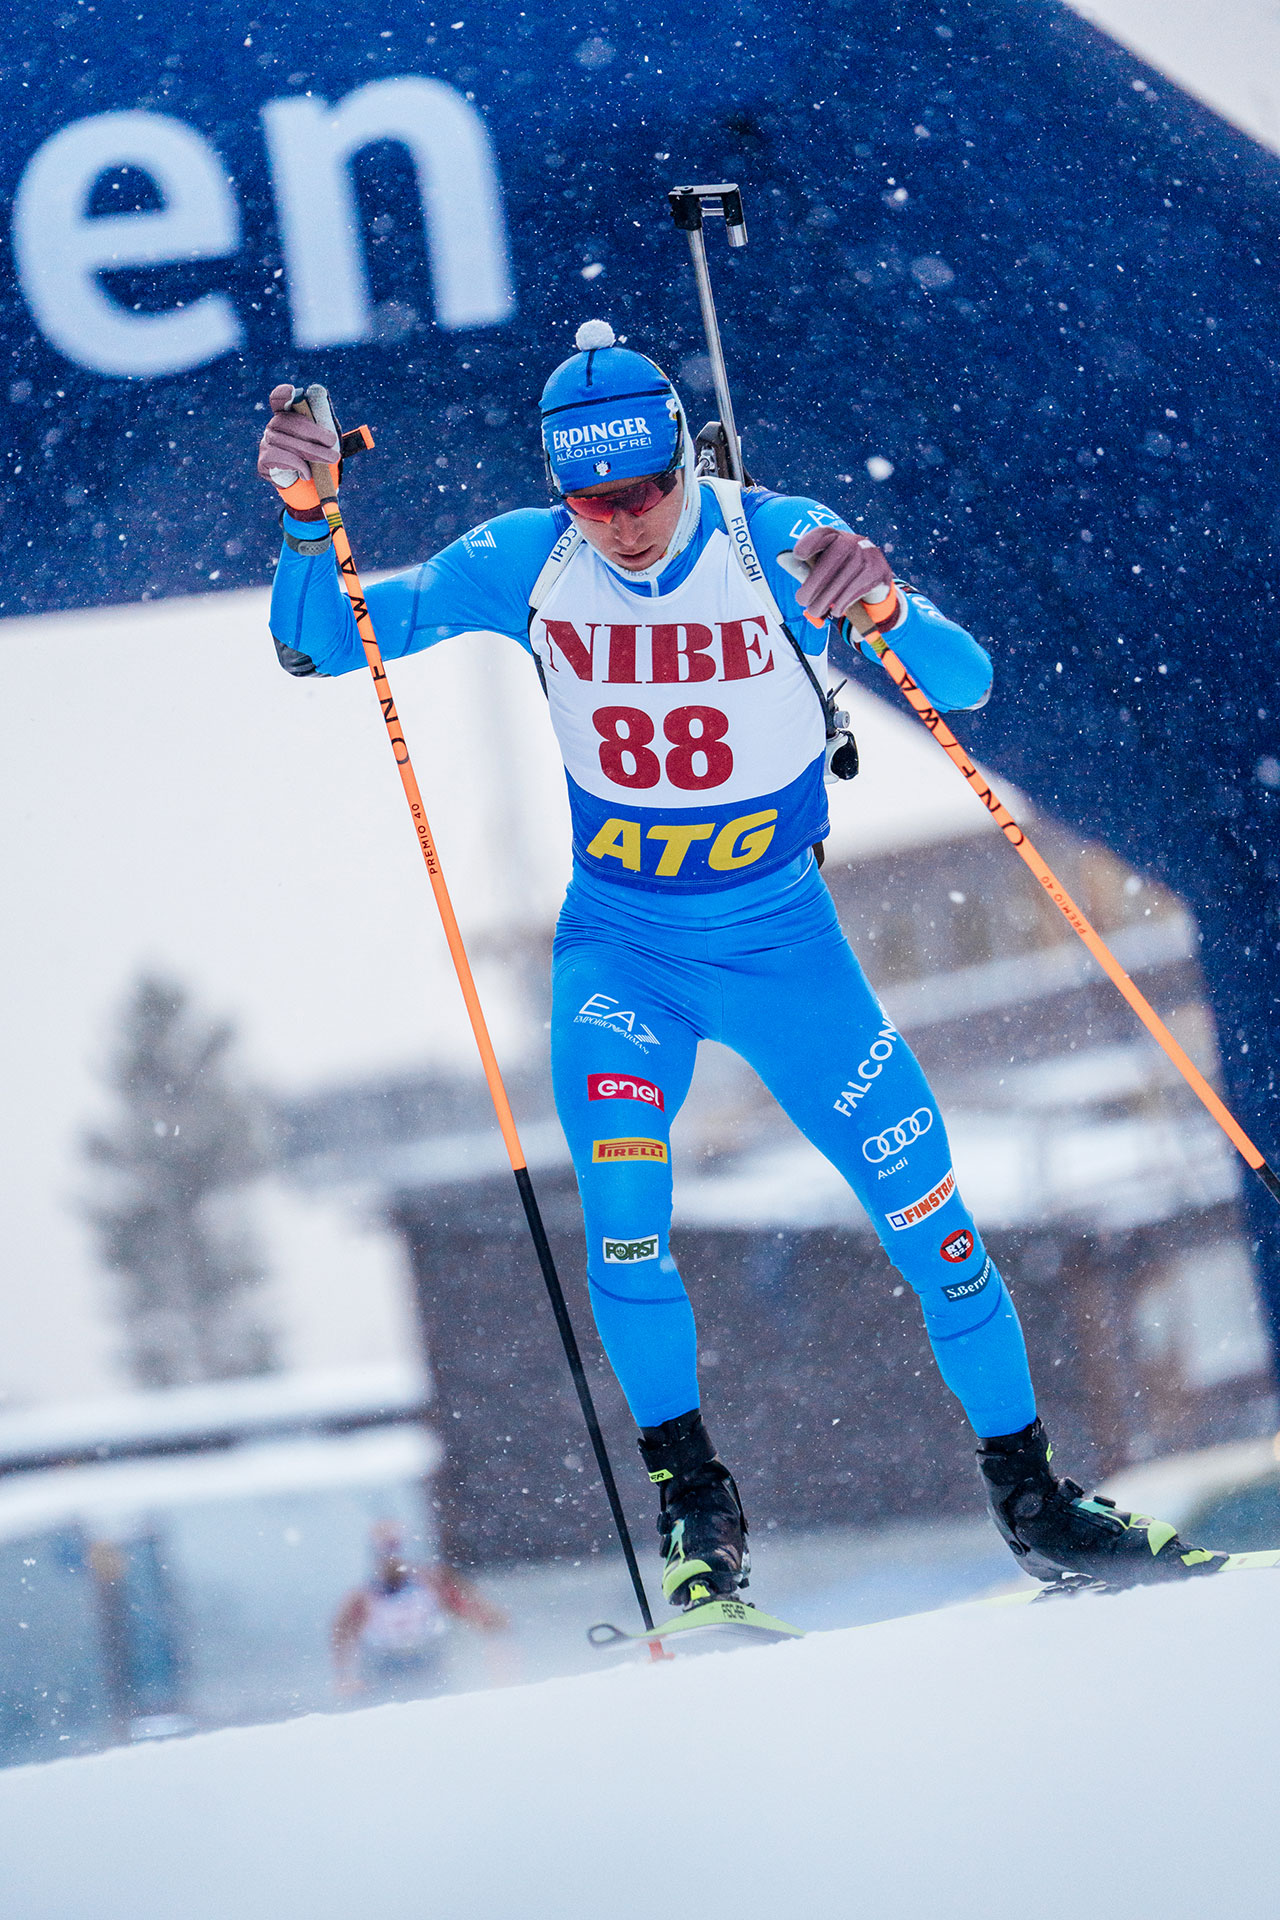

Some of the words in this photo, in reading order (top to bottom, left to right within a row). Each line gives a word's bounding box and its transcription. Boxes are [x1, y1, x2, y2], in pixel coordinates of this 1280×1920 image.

[11, 74, 515, 376] en
[552, 417, 652, 450] ERDINGER
[556, 437, 652, 462] ALKOHOLFREI
[550, 527, 578, 563] CCHI
[731, 516, 762, 582] FIOCCHI
[540, 615, 774, 684] NIBE
[592, 705, 734, 790] 88
[411, 803, 421, 819] 40
[417, 825, 438, 875] PREMIO
[586, 809, 778, 876] ATG
[1053, 893, 1087, 934] PREMIO
[573, 1015, 613, 1030] EMPORIO
[597, 1079, 660, 1106] enel
[598, 1141, 664, 1159] PIRELLI
[878, 1156, 909, 1181] Audi
[605, 1238, 658, 1261] FORST
[945, 1236, 969, 1254] RTL
